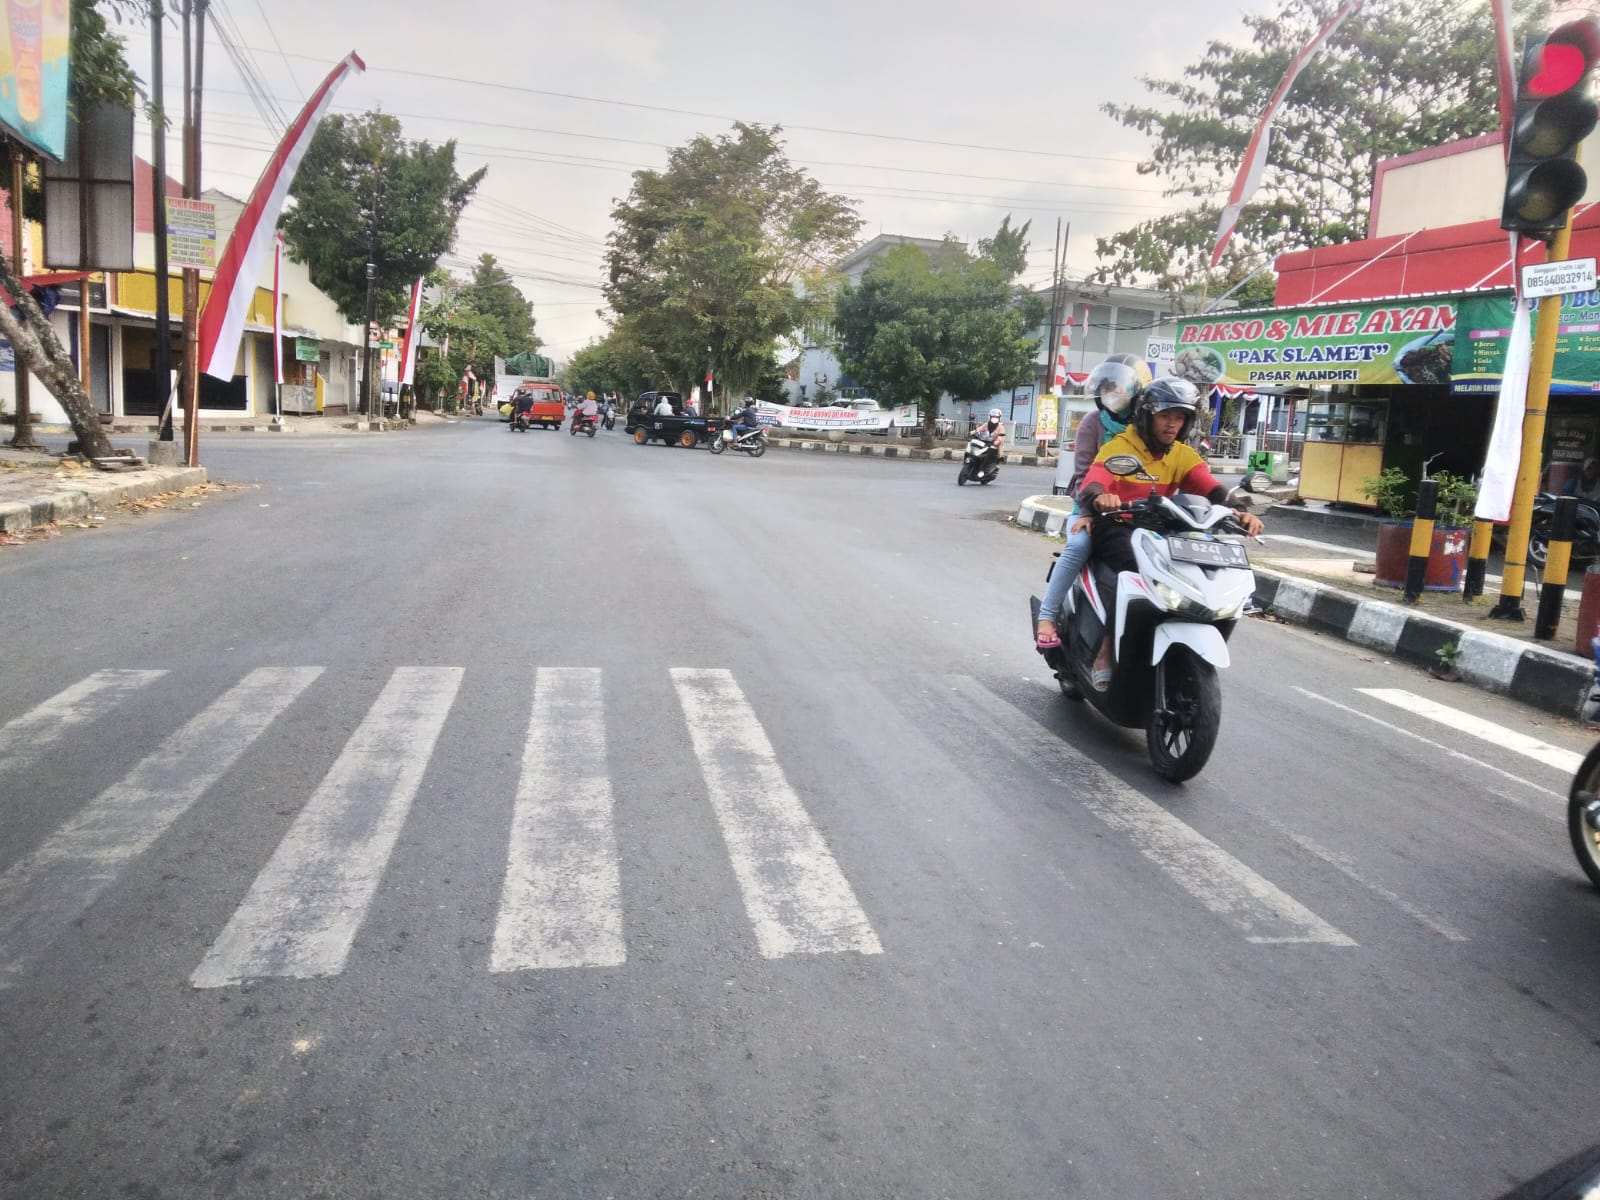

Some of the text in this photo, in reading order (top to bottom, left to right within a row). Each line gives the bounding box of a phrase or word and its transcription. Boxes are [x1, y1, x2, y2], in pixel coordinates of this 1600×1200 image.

[1527, 271, 1592, 288] 085640832914
[1180, 319, 1264, 343] BAKSO
[1266, 317, 1290, 341] &
[1292, 311, 1357, 338] MIE
[1249, 369, 1358, 381] PASAR MANDIRI
[1173, 540, 1183, 550] R
